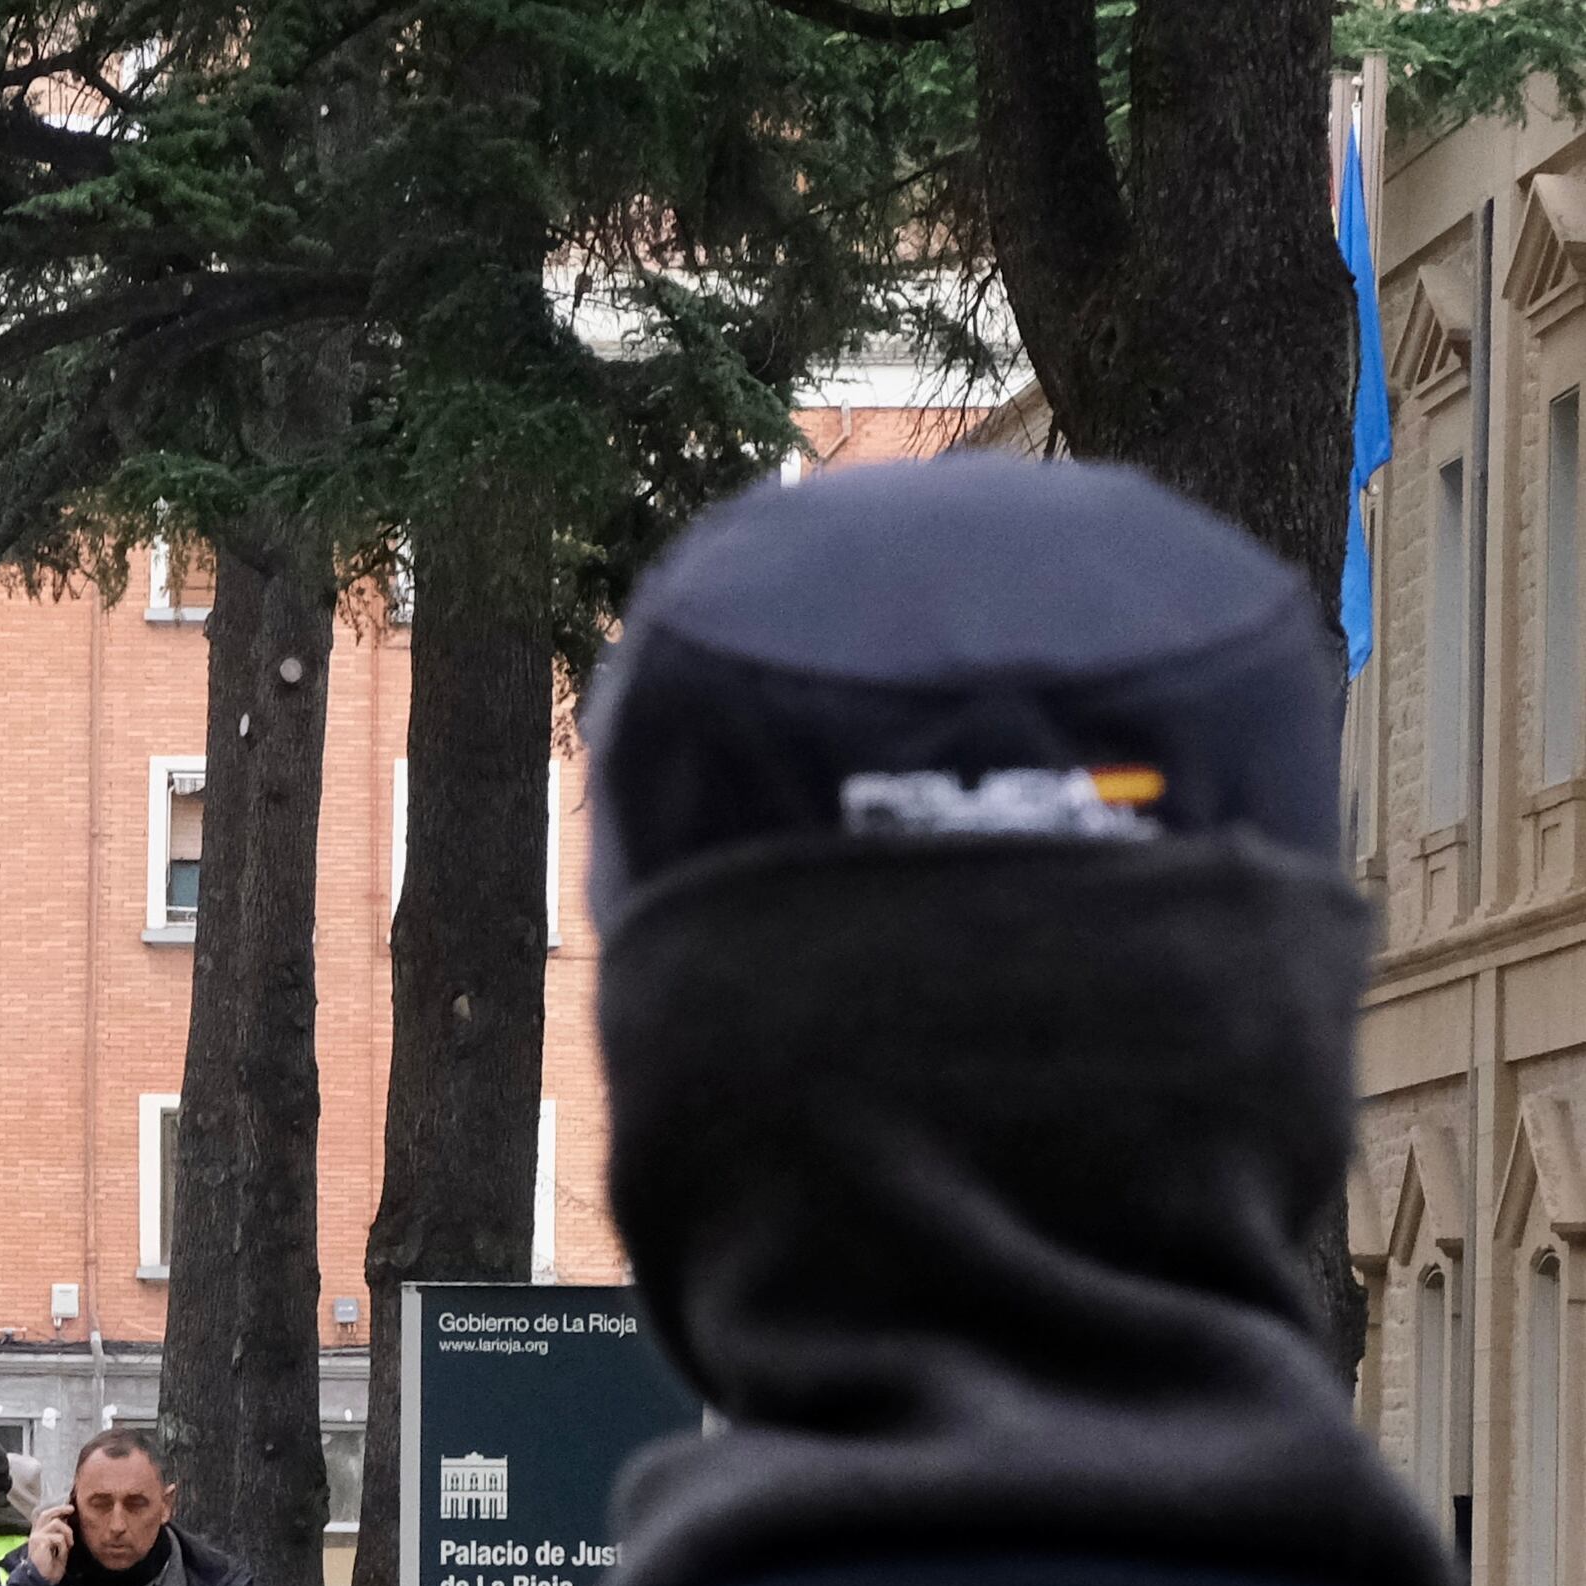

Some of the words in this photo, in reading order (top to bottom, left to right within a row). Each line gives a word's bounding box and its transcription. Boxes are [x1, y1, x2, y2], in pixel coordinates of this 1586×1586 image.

[438, 1312, 529, 1333] Gobierno
[534, 1313, 559, 1333] de
[563, 1313, 585, 1333] La
[589, 1313, 638, 1338] Rioja
[439, 1337, 549, 1356] www.larioja.org
[440, 1539, 528, 1566] Palacio
[535, 1540, 565, 1566] de
